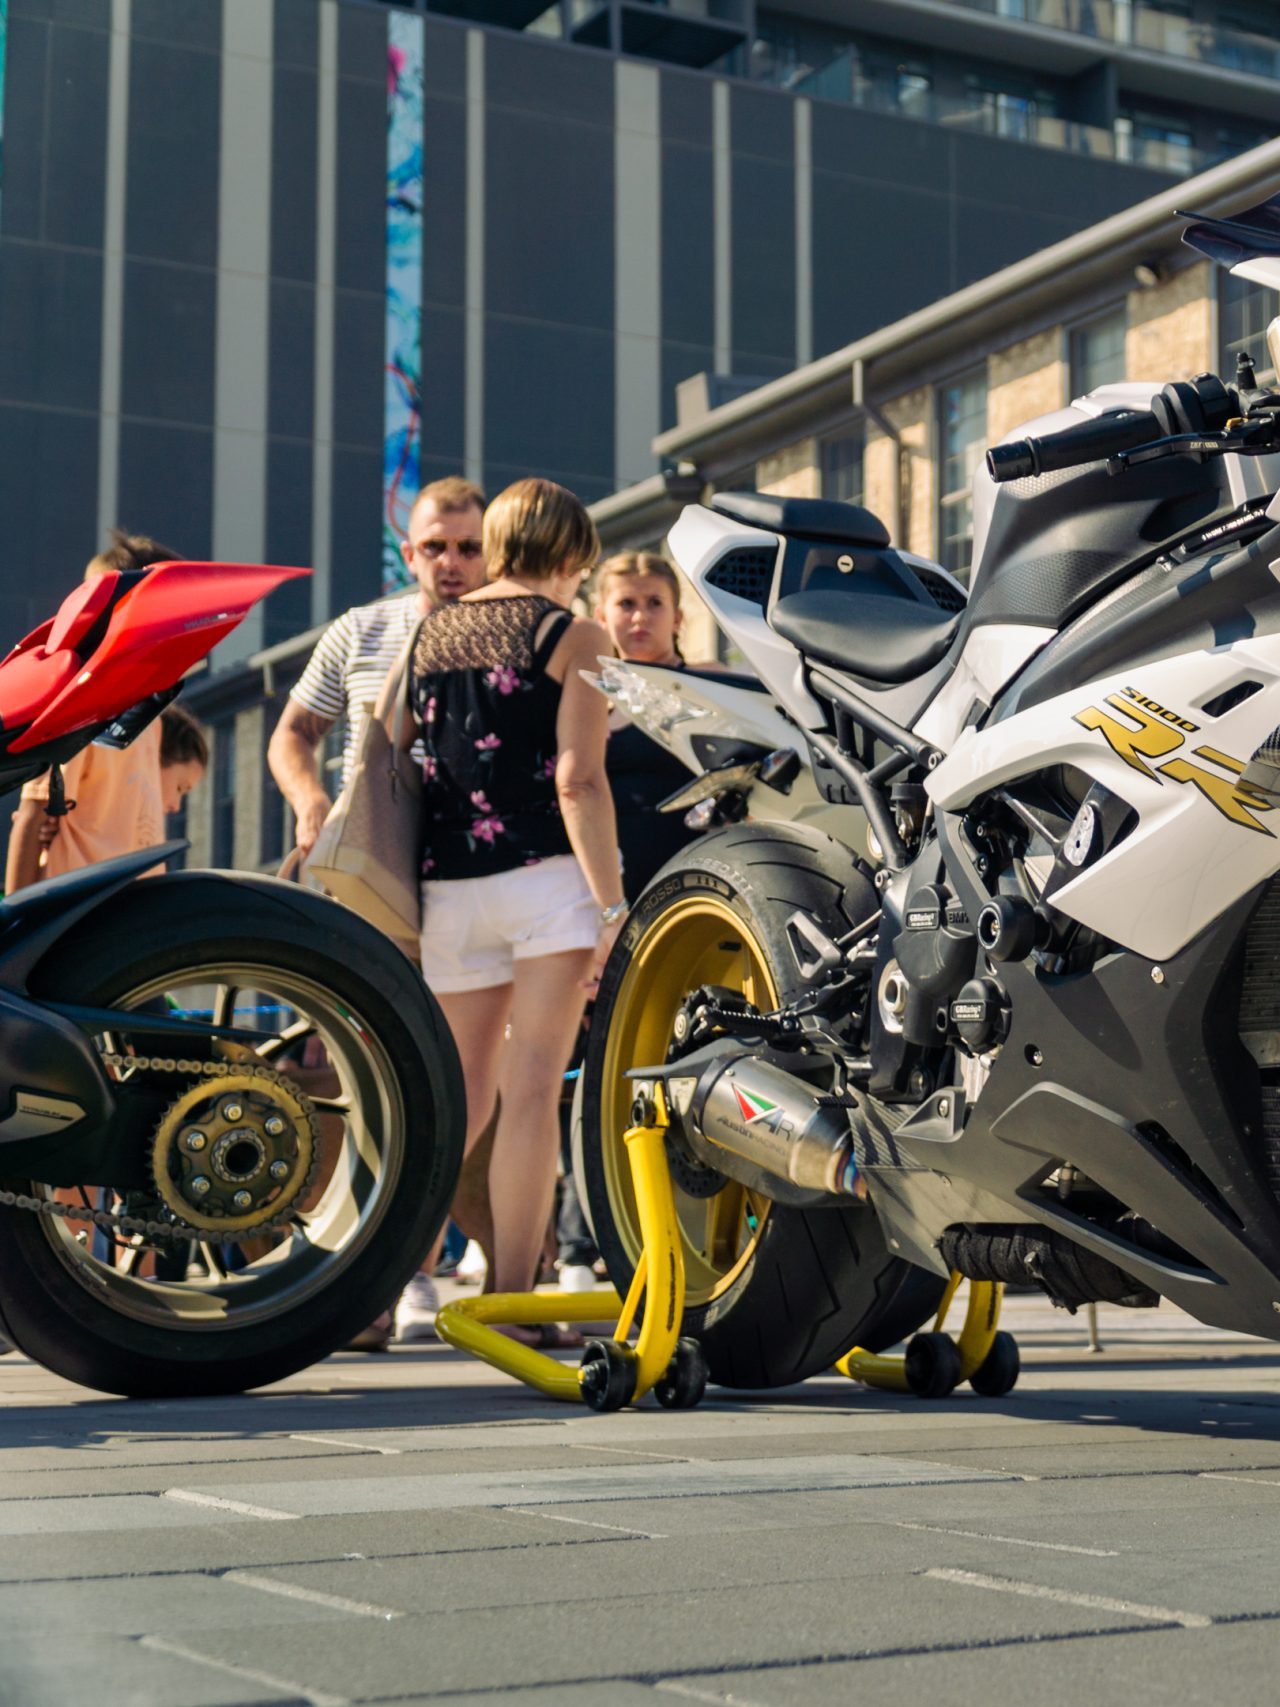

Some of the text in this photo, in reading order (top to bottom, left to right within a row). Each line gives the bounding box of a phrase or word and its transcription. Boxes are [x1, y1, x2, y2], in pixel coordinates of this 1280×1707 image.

[1120, 686, 1201, 733] S1000
[1071, 692, 1279, 838] RR
[641, 876, 718, 915] ROSSO III
